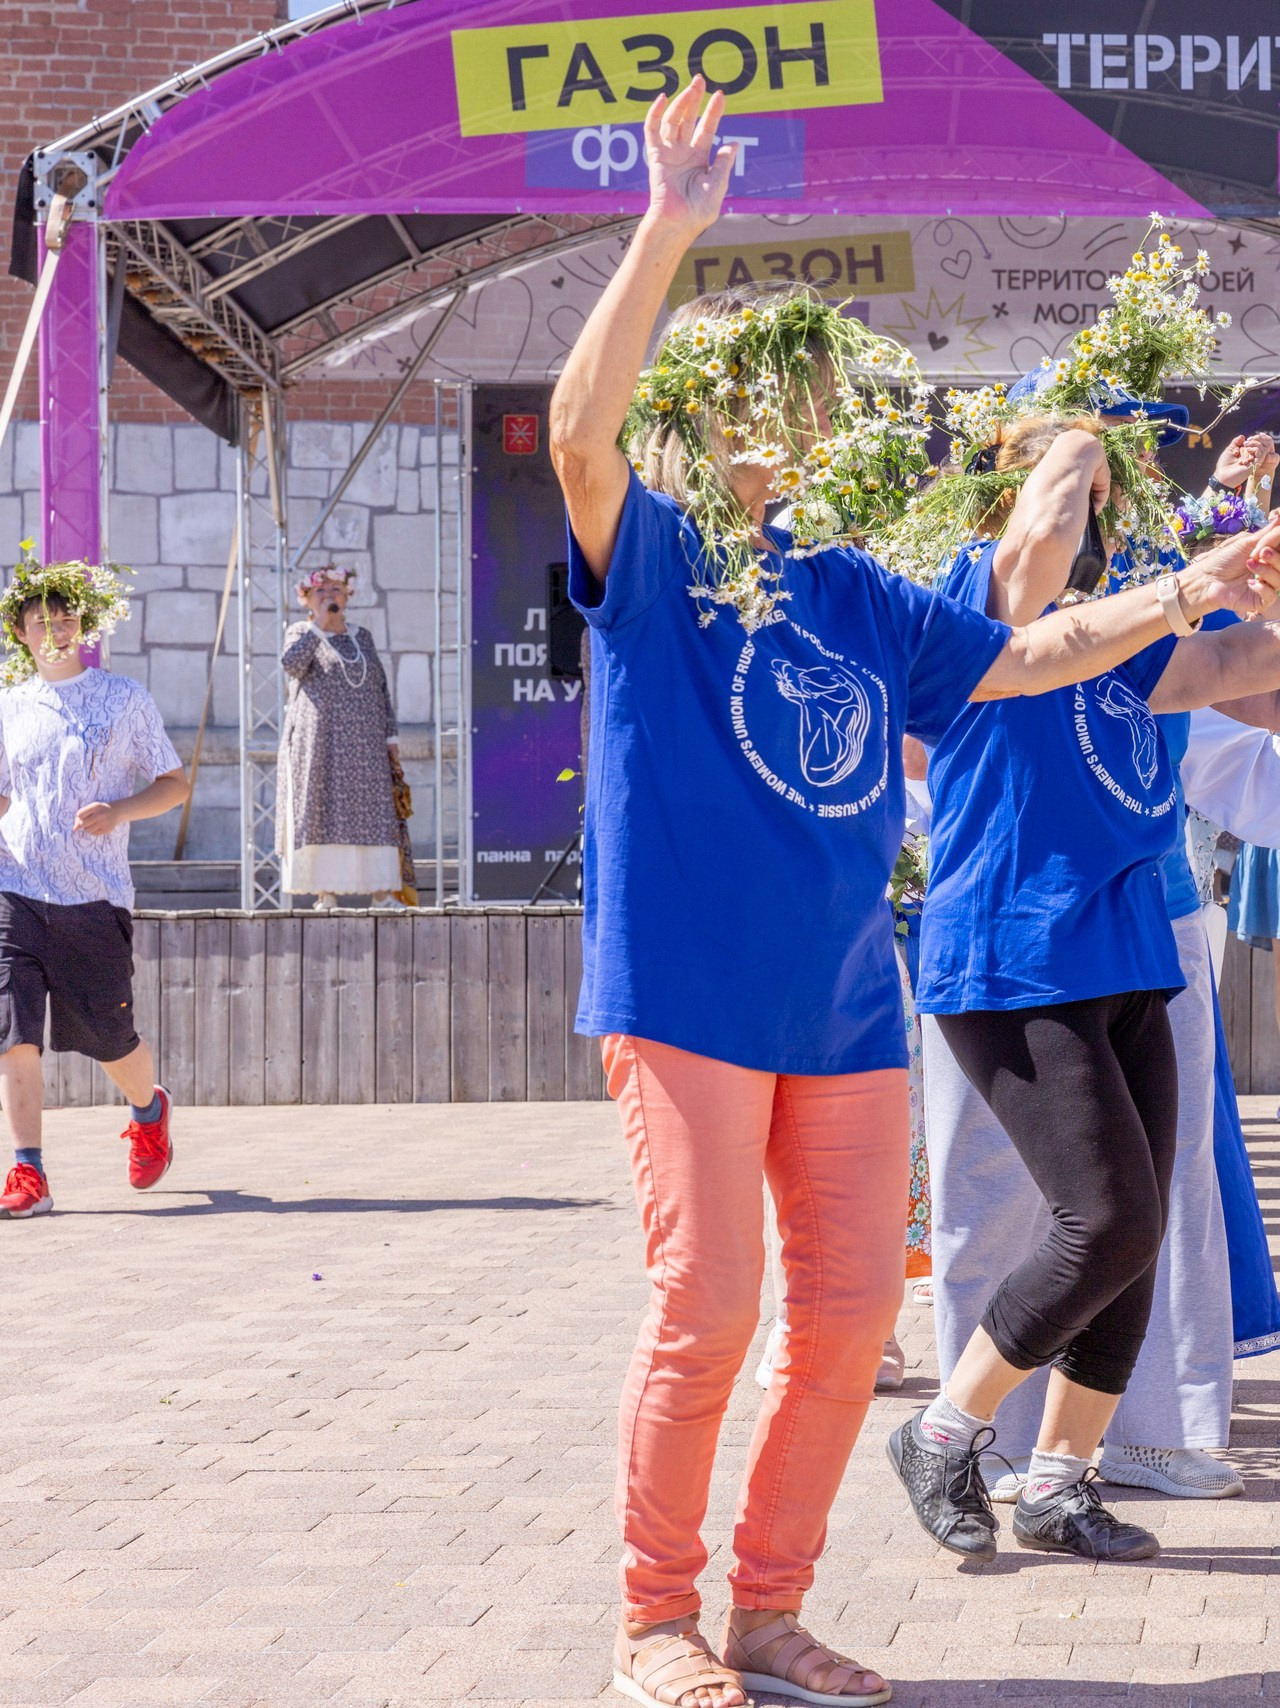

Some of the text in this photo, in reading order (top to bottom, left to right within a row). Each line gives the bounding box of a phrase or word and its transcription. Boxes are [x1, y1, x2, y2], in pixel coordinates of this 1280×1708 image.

[505, 22, 830, 112] ГАЗОН
[571, 124, 760, 187] фт
[694, 244, 885, 297] ГАЗОН
[513, 679, 556, 702] НА
[731, 674, 746, 693] OF
[730, 695, 749, 740] UNION
[1074, 693, 1087, 711] OF
[1074, 713, 1094, 755] UNION
[740, 739, 788, 796] WOMEN'S
[1086, 754, 1126, 804] WOMEN'S
[785, 787, 807, 809] THE
[817, 802, 860, 818] RUSSIE
[1123, 794, 1143, 815] THE
[477, 850, 532, 863] панна
